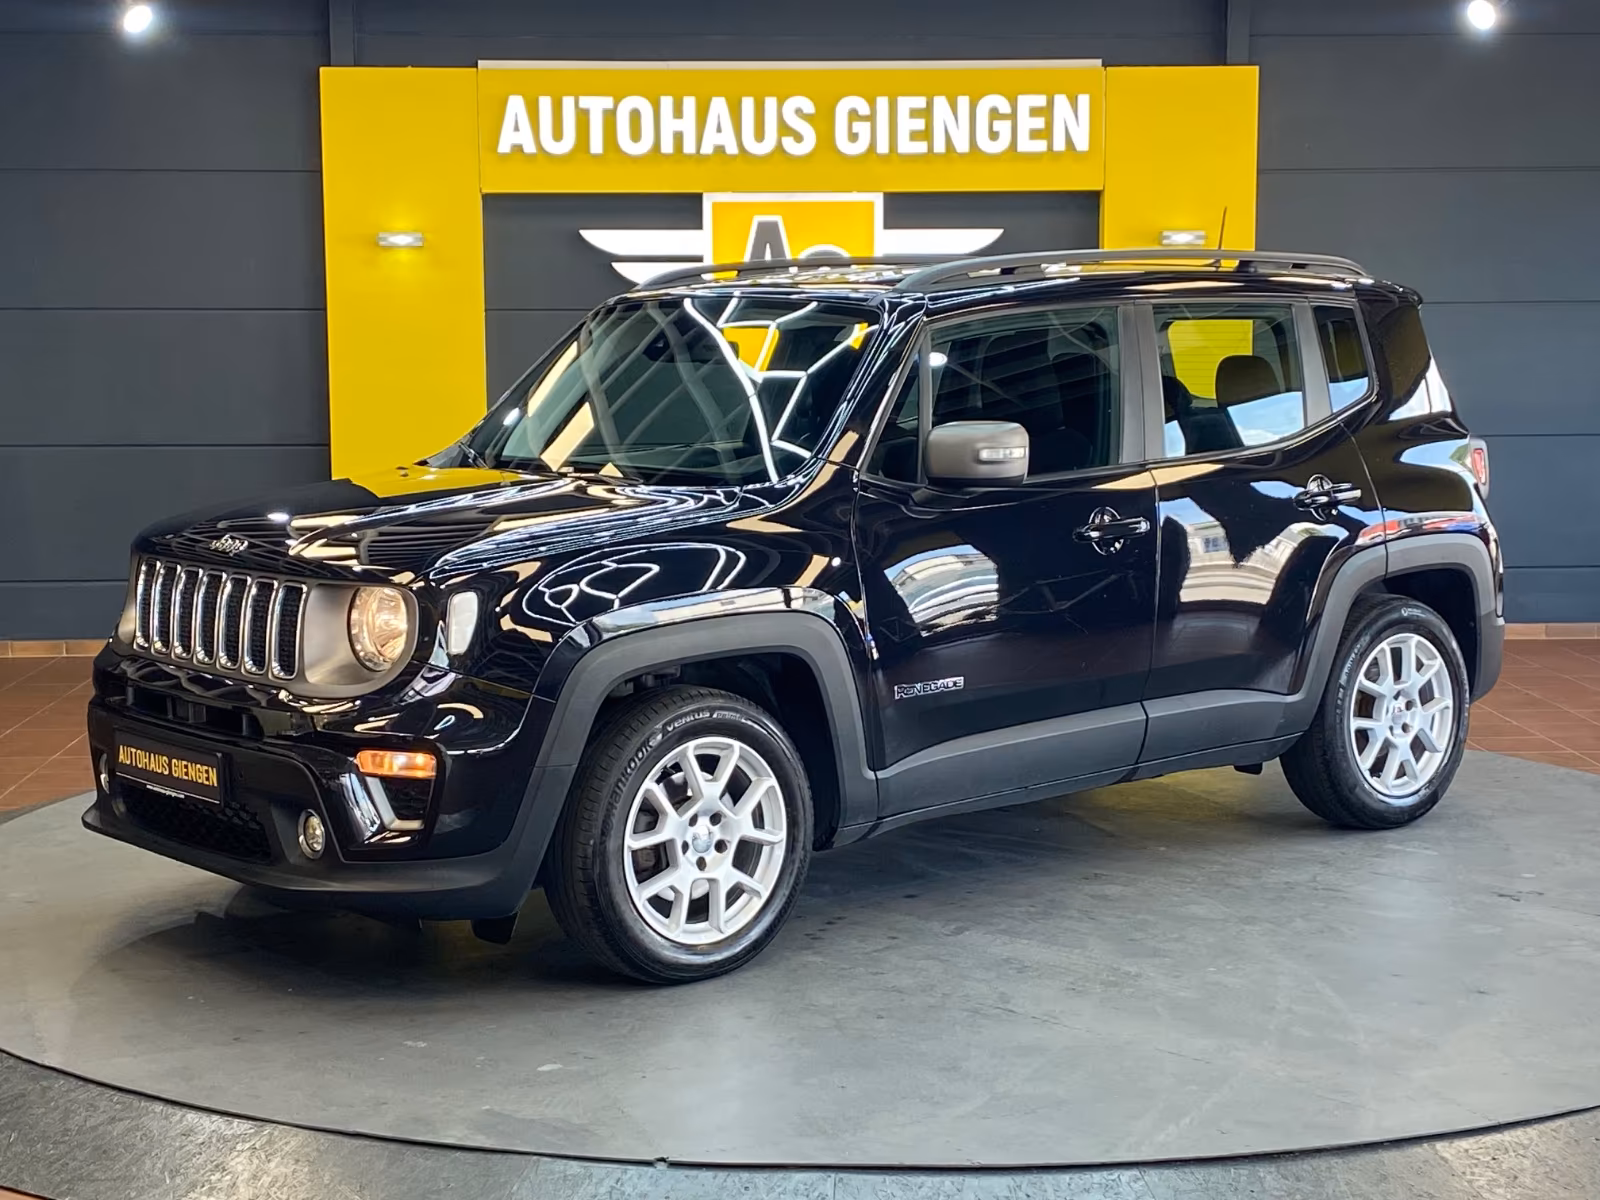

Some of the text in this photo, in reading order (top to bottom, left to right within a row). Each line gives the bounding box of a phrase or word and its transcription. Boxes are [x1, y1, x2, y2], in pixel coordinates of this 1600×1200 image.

[497, 94, 1090, 156] AUTOHAUS GIENGEN
[894, 676, 964, 700] RENEGADE
[118, 745, 218, 787] AUTOHAUS GIENGEN
